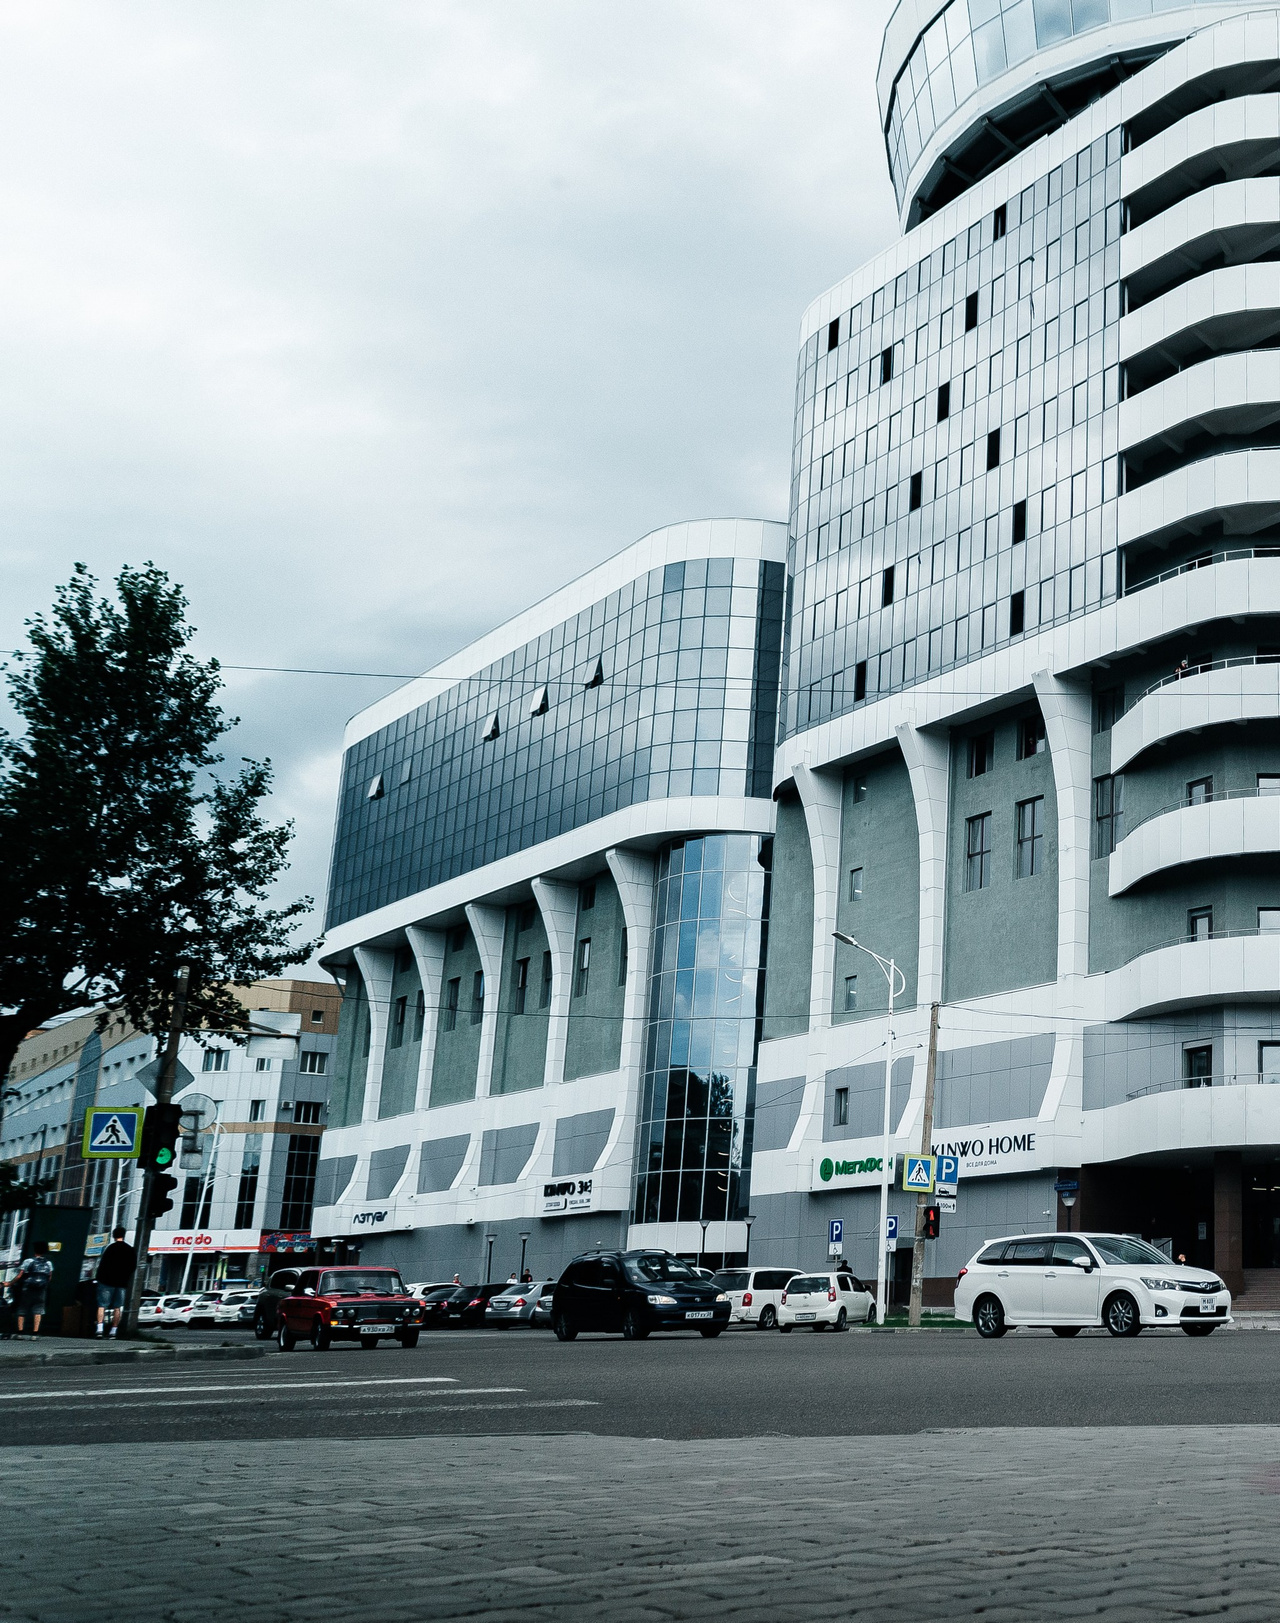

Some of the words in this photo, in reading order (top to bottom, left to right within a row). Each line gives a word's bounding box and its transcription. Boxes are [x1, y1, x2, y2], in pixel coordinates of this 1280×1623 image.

[931, 1139, 984, 1158] KINWO
[989, 1133, 1036, 1155] HOME
[941, 1158, 955, 1181] P
[833, 1222, 841, 1240] P
[886, 1218, 896, 1237] P
